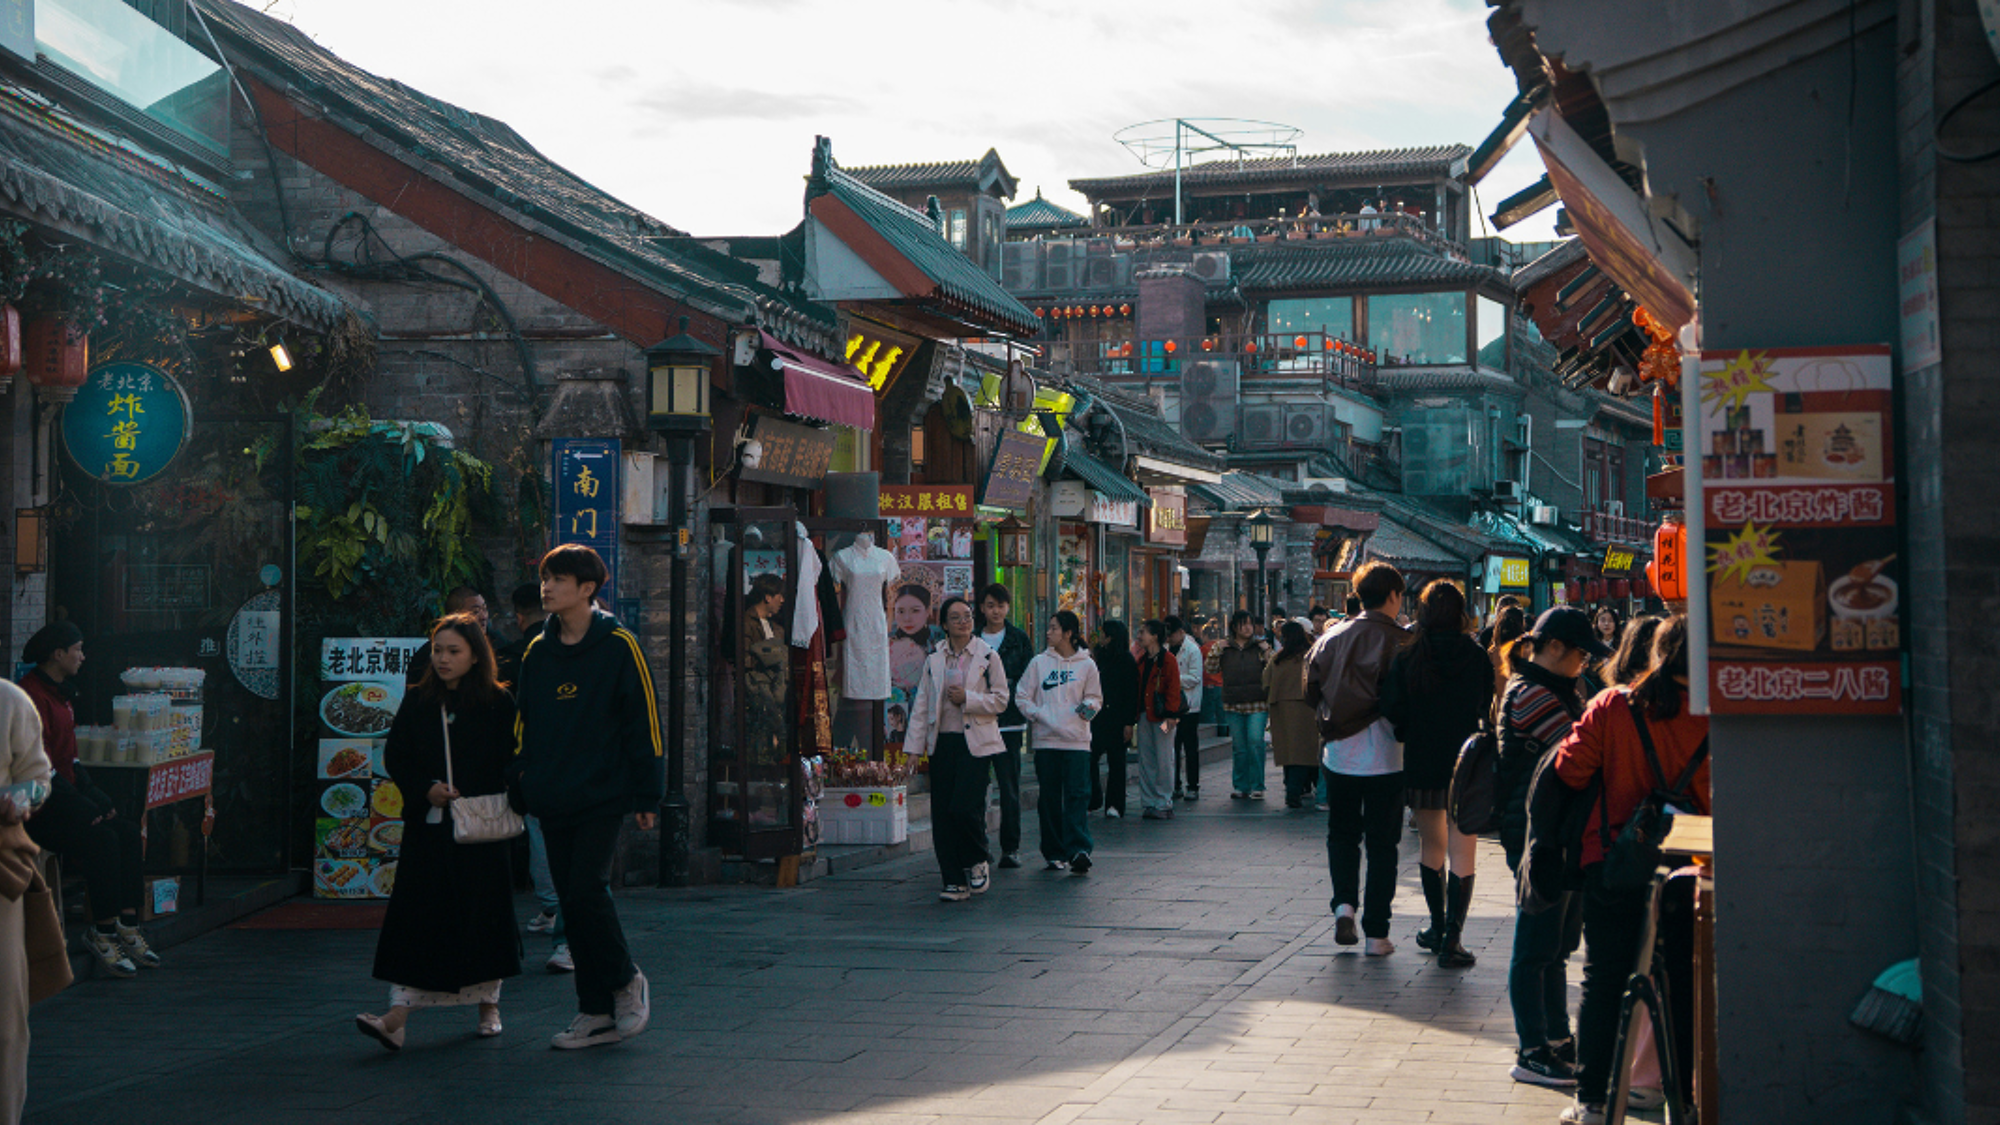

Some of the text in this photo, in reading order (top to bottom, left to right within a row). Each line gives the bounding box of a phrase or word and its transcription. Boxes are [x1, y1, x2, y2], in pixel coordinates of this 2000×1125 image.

[97, 371, 154, 393] 老北京
[571, 464, 600, 539] 南门
[1712, 488, 1883, 522] 老北京炸酱
[1717, 665, 1890, 700] 老北京二八酱
